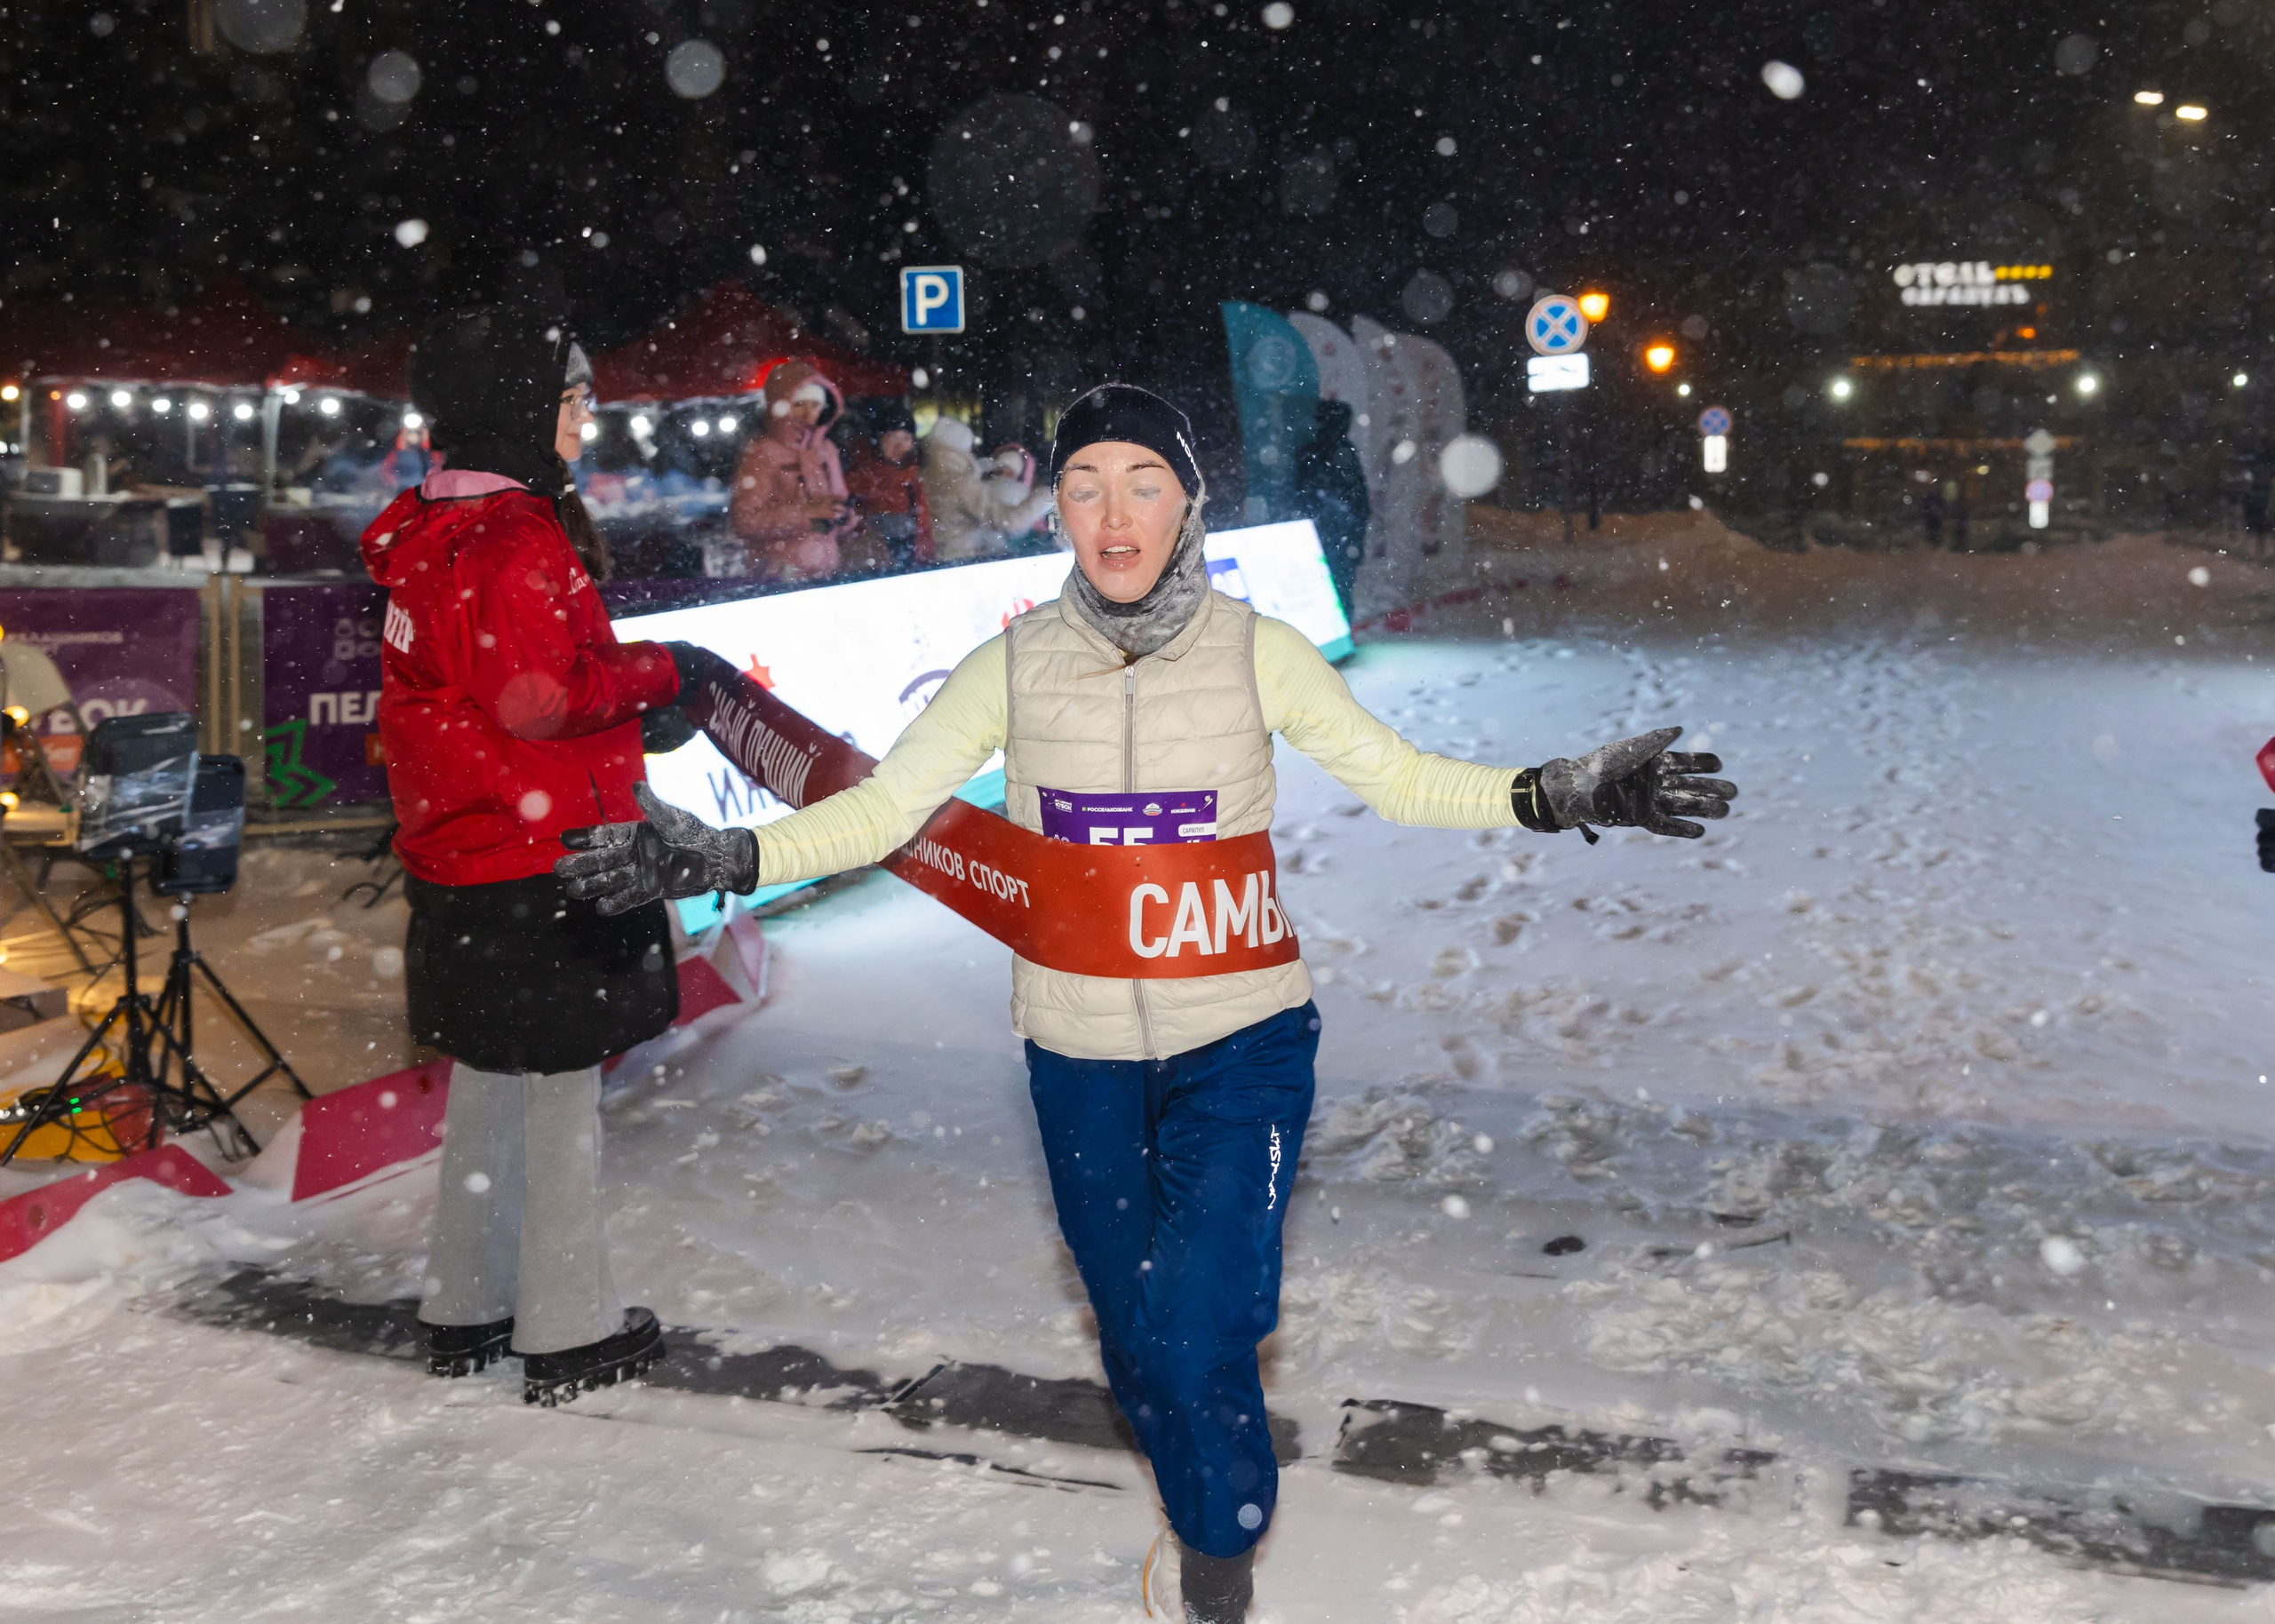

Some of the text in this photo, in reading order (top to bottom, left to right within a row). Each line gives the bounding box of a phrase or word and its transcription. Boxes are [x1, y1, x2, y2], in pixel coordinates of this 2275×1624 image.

[915, 275, 949, 326] P
[970, 859, 1030, 909] СПОРТ
[1129, 870, 1297, 959] САМЫ
